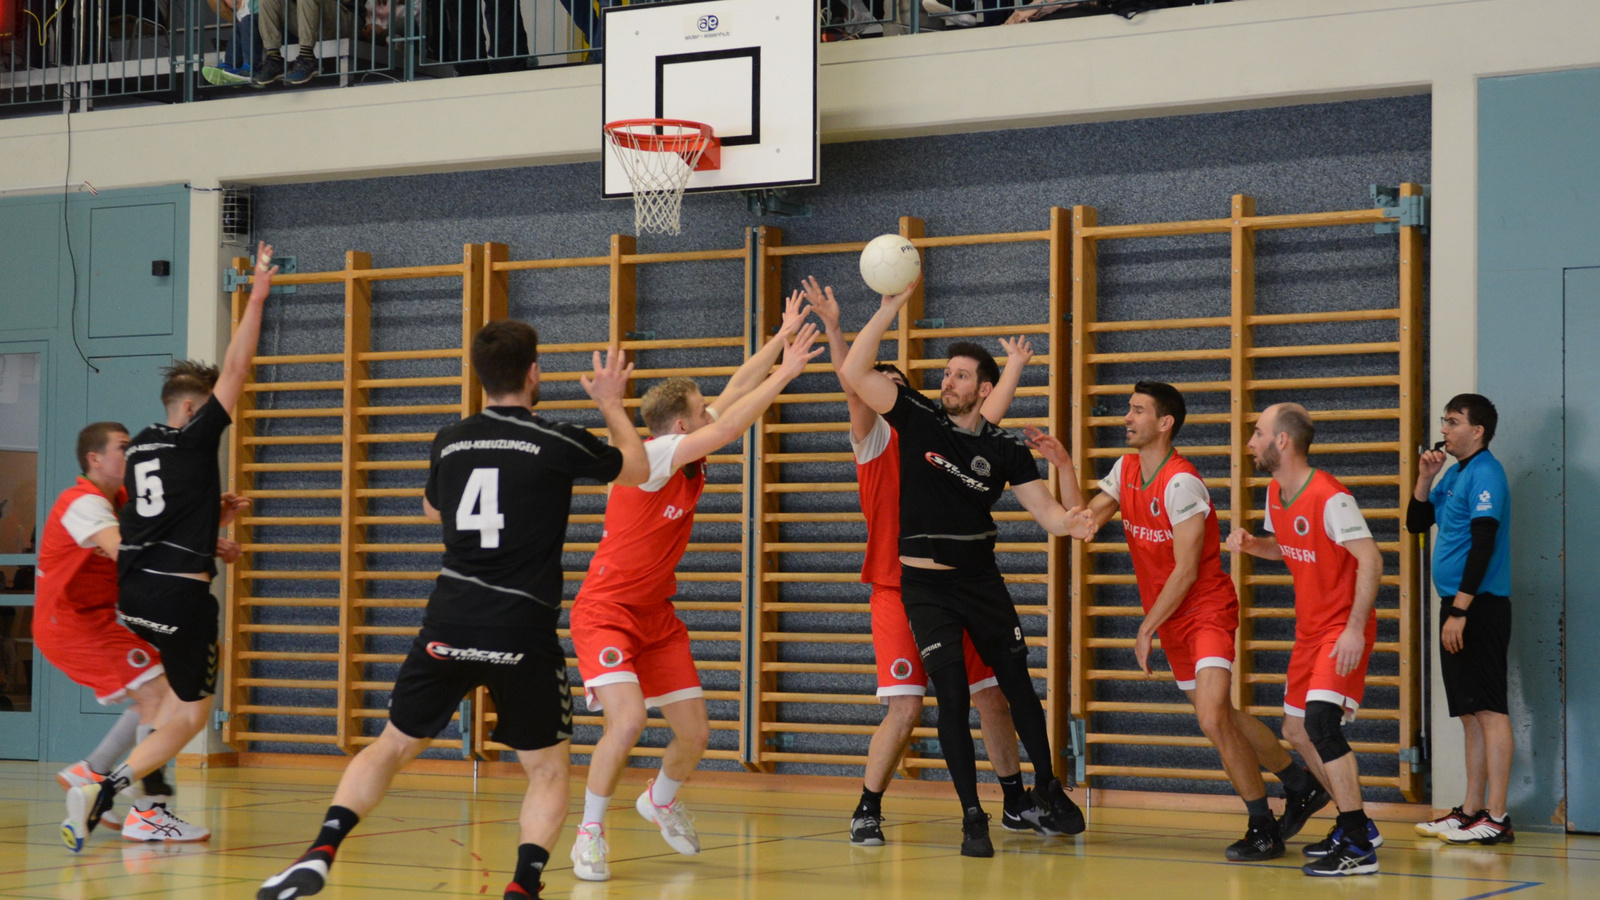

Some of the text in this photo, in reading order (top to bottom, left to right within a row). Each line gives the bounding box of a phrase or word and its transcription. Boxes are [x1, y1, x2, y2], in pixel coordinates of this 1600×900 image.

[133, 457, 167, 519] 5
[455, 467, 505, 549] 4
[662, 504, 684, 520] RA
[1013, 626, 1023, 641] 9
[432, 645, 524, 661] STÖCKLI
